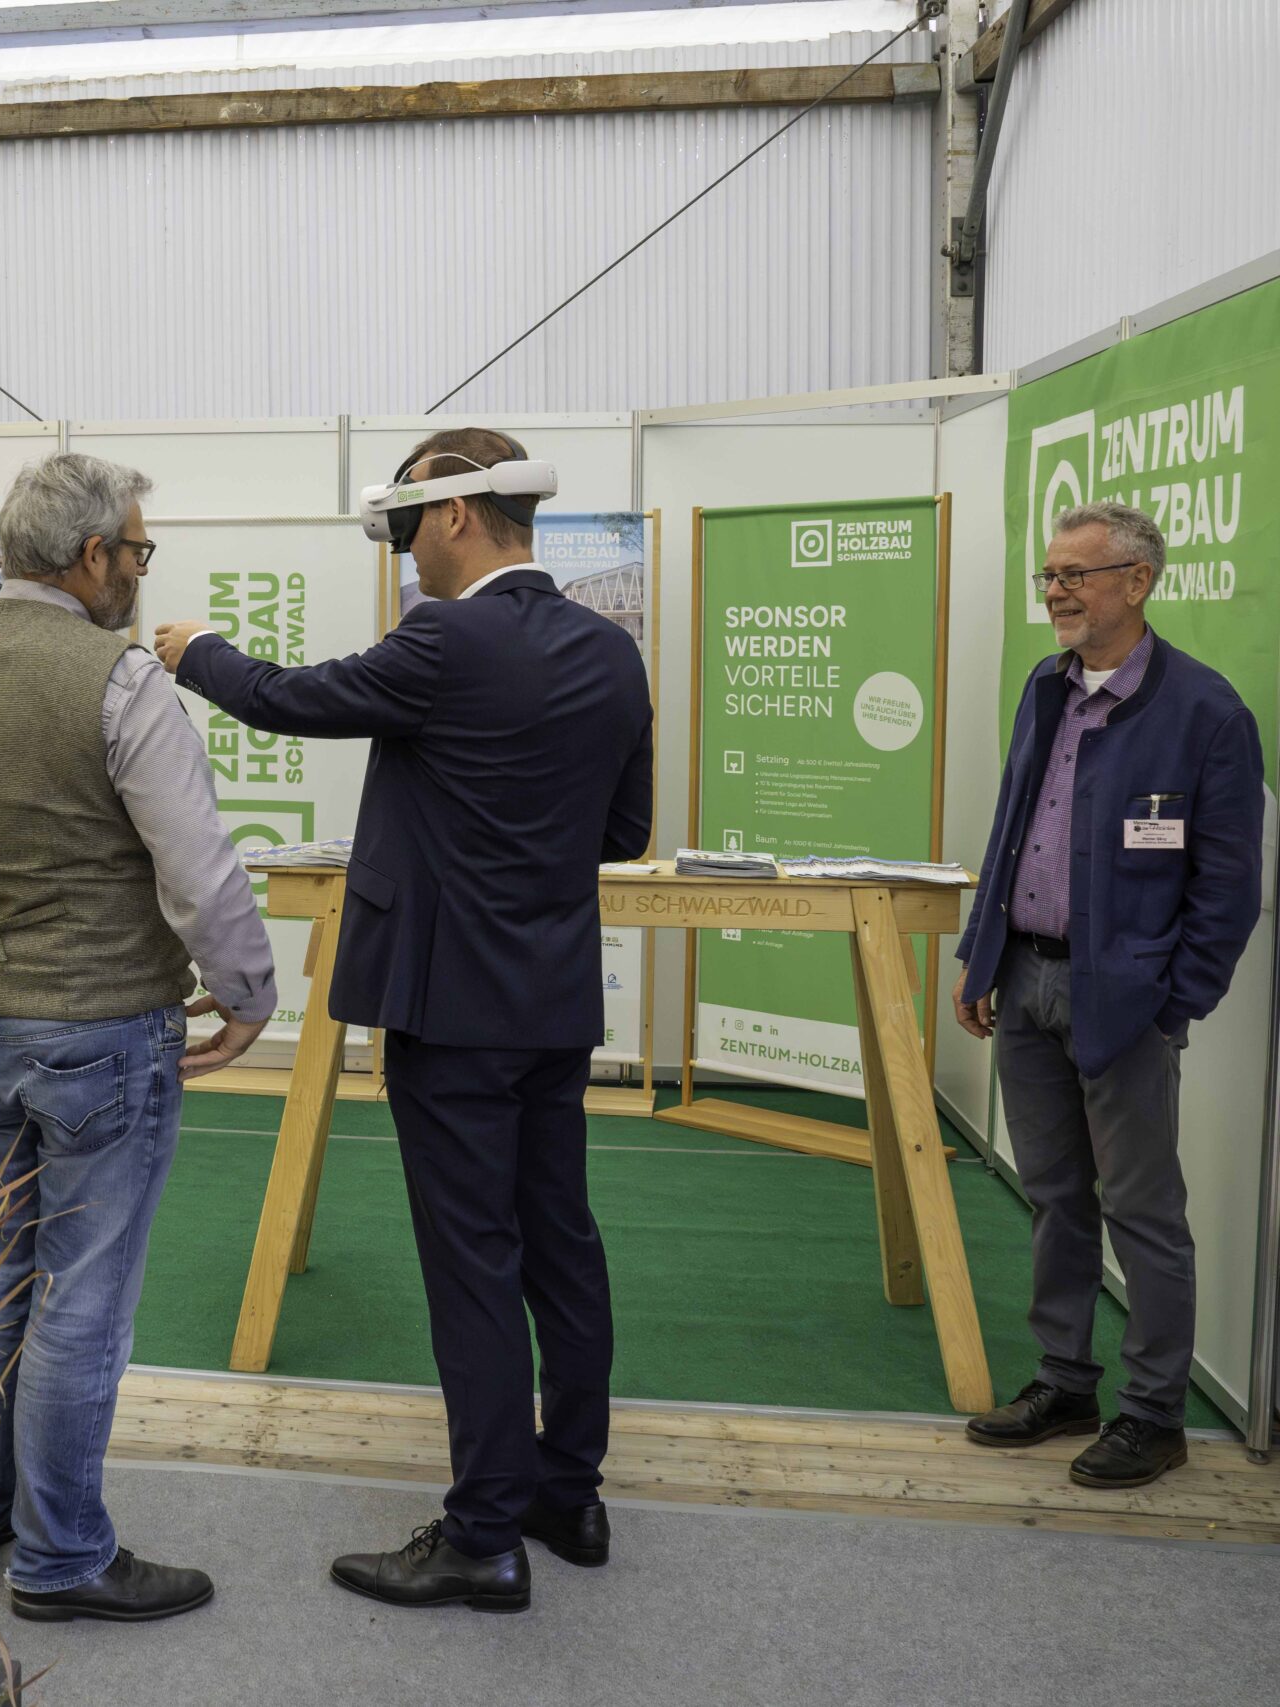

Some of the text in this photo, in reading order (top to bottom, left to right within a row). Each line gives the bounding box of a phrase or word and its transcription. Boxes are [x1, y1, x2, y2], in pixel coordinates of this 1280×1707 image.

[1101, 385, 1245, 482] ZENTRUM
[1102, 472, 1242, 548] ZBAU
[544, 532, 620, 544] ZENTRUM
[837, 520, 912, 536] ZENTRUM
[544, 546, 620, 559] HOLZBAU
[837, 535, 912, 551] HOLZBAU
[544, 560, 620, 568] SCHWARZWALD
[836, 551, 912, 562] SCHWARZWALD
[1150, 560, 1236, 601] RZWALD
[725, 605, 847, 628] SPONSOR
[724, 635, 831, 658] WERDEN
[208, 572, 240, 783] ZENUM
[246, 572, 280, 783] HOBAU
[285, 572, 305, 784] SCHZWALD
[724, 665, 841, 688] VORTEILE
[724, 693, 833, 718] SICHERN
[861, 703, 875, 712] UNS
[876, 705, 897, 716] AUCH
[868, 696, 911, 709] WIR FREUEN
[862, 711, 913, 727] IHRE SPENDEN
[756, 754, 790, 766] Setzling
[755, 834, 778, 844] Baum
[635, 895, 812, 917] SCHWARZWALD
[720, 1037, 862, 1075] ZENTRUM-HOLZBA
